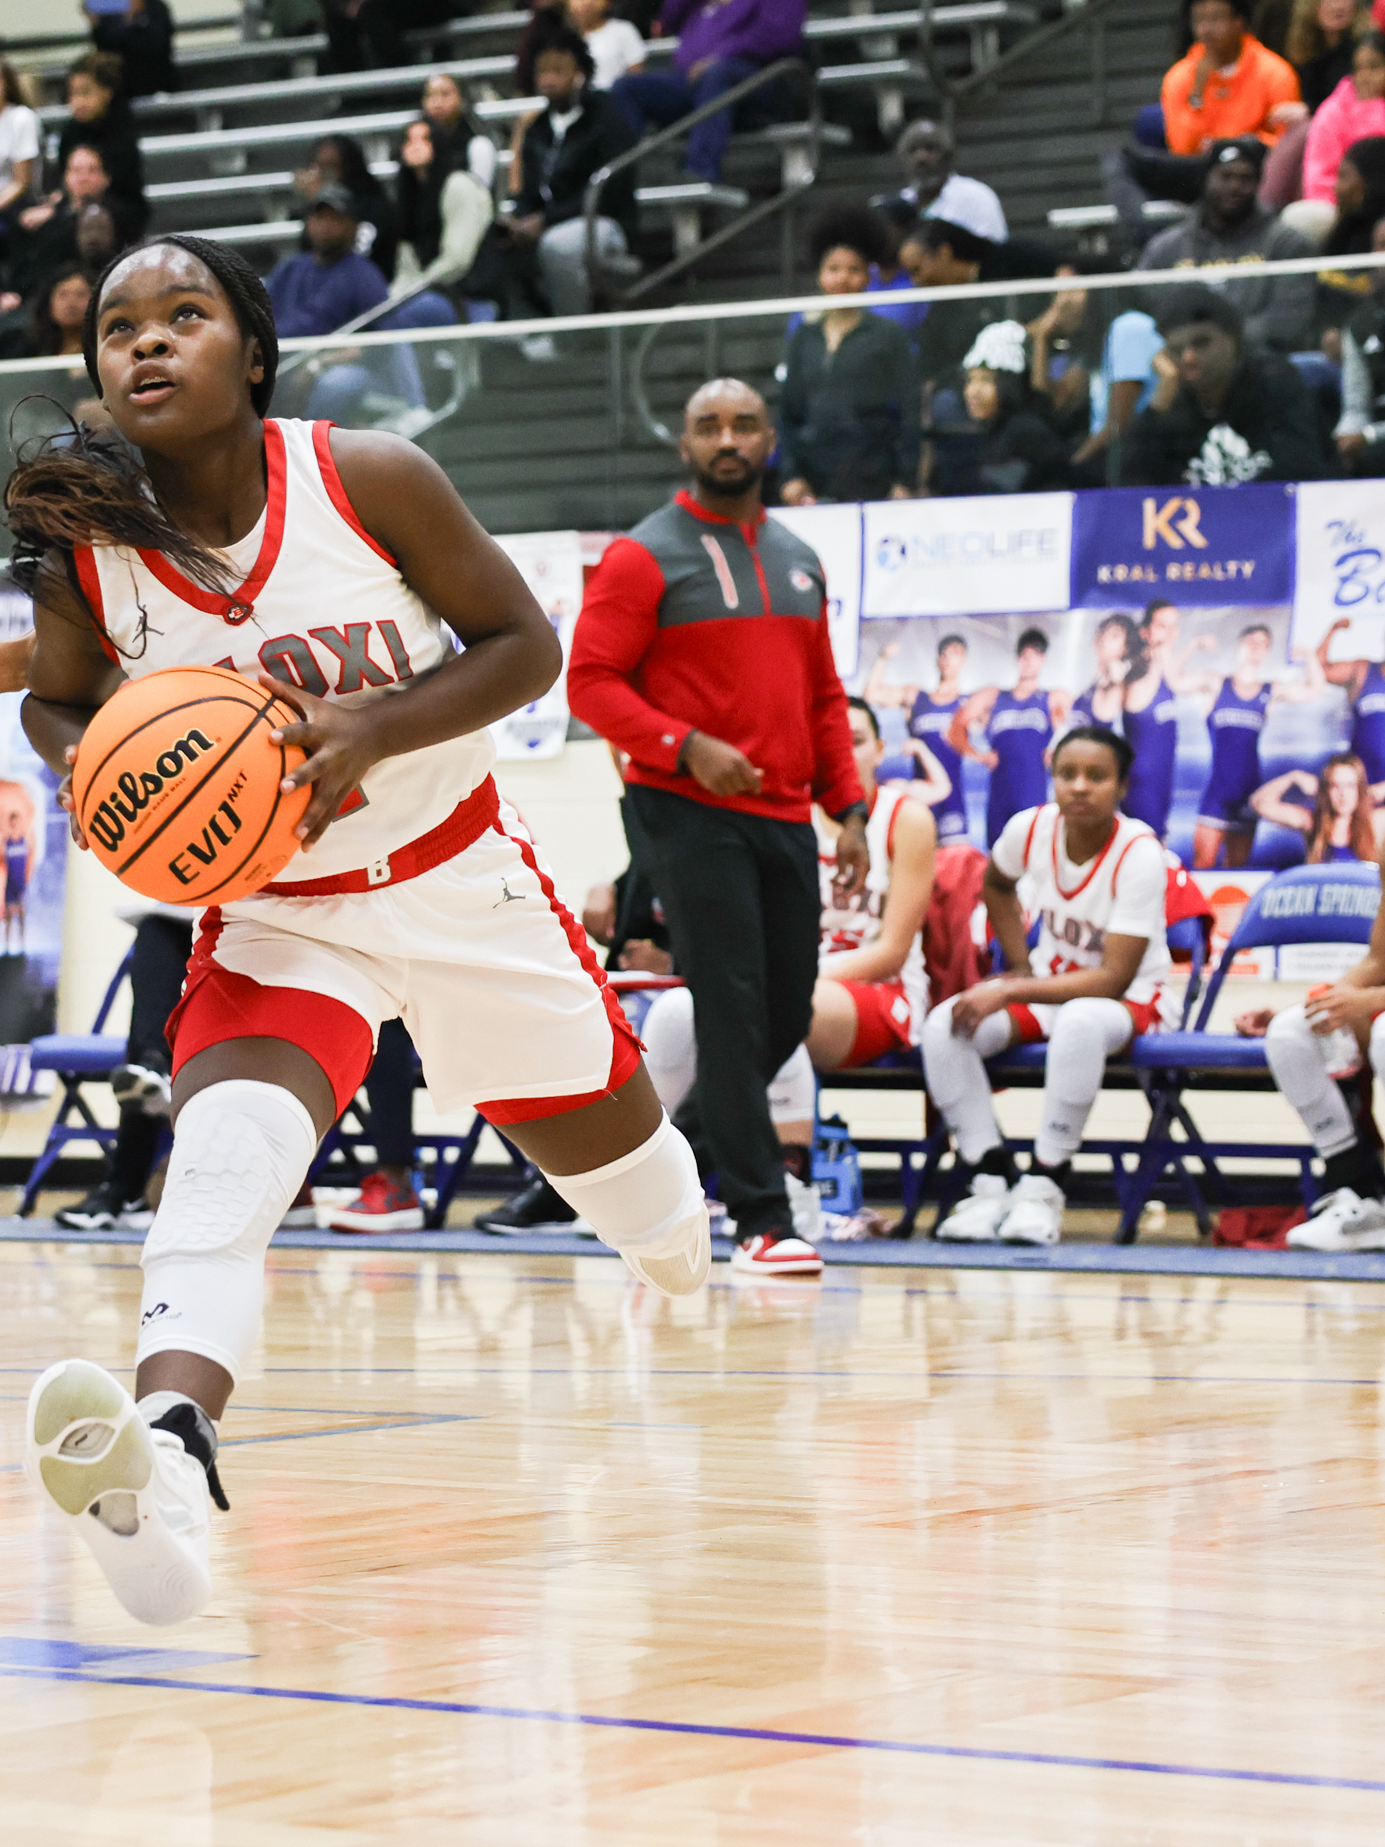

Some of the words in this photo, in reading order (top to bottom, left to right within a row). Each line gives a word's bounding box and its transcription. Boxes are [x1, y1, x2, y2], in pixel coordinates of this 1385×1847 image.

[1142, 497, 1209, 550] KR
[1096, 563, 1159, 583] KRAL
[1165, 560, 1256, 581] REALTY
[212, 619, 414, 698] OXI
[88, 728, 214, 852] Wilson
[226, 770, 249, 803] NXT
